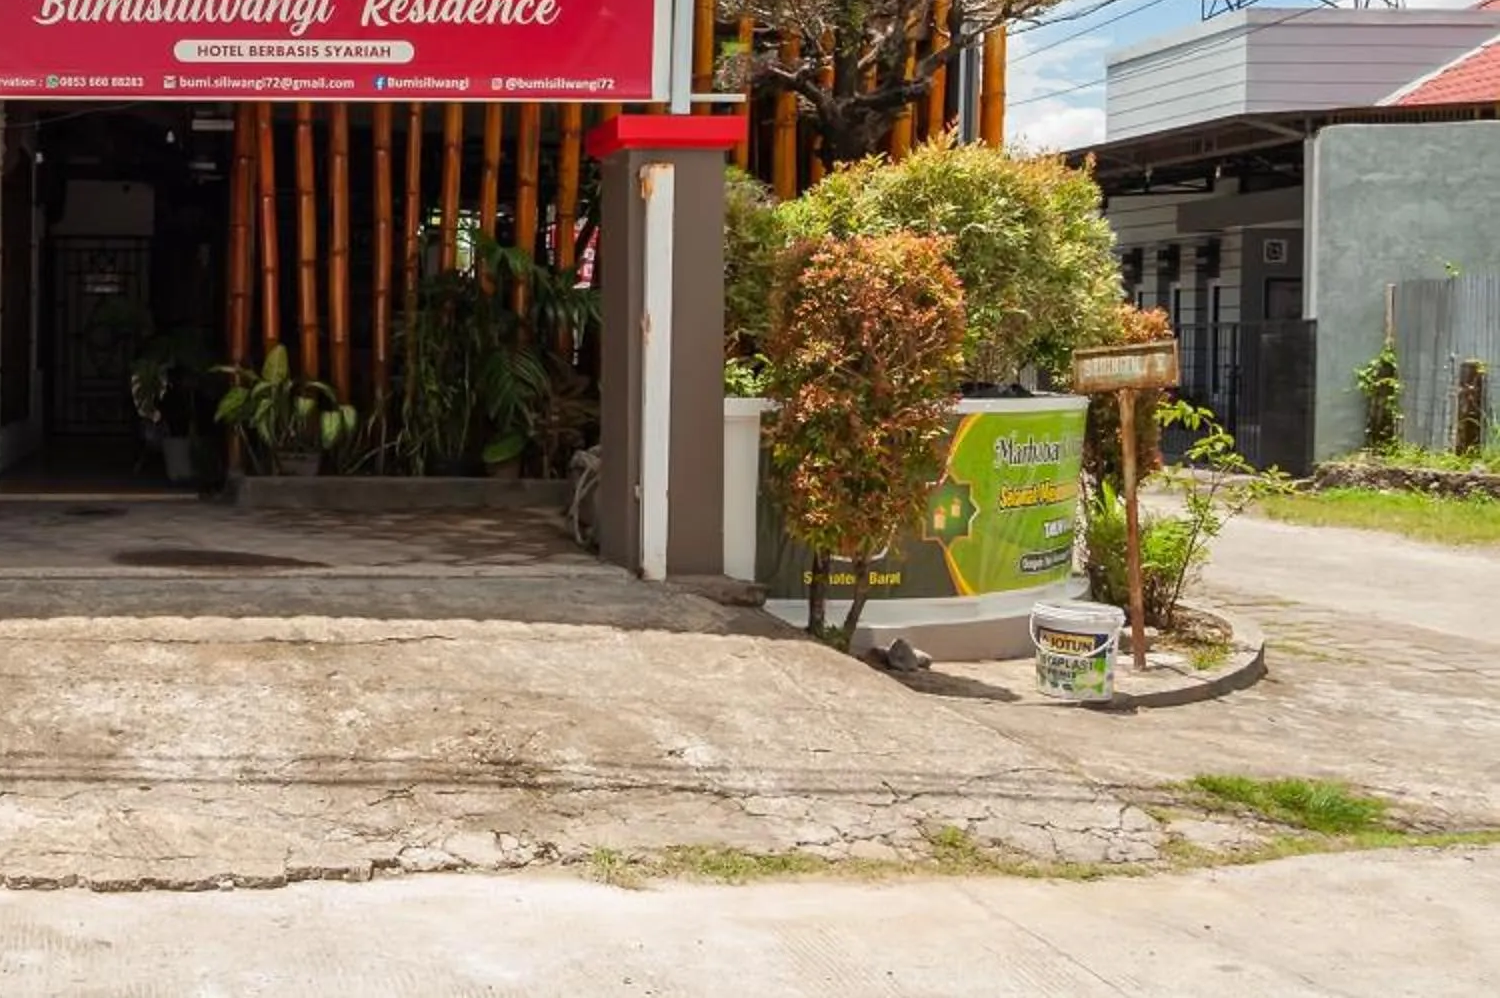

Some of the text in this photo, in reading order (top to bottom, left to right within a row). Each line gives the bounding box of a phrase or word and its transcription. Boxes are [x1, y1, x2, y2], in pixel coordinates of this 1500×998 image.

[197, 45, 391, 59] HOTEL BERBASIS SYARIAH
[179, 76, 355, 91] bumi.siliwangi72@gmail.com
[505, 77, 616, 92] @bumisiliwangi72
